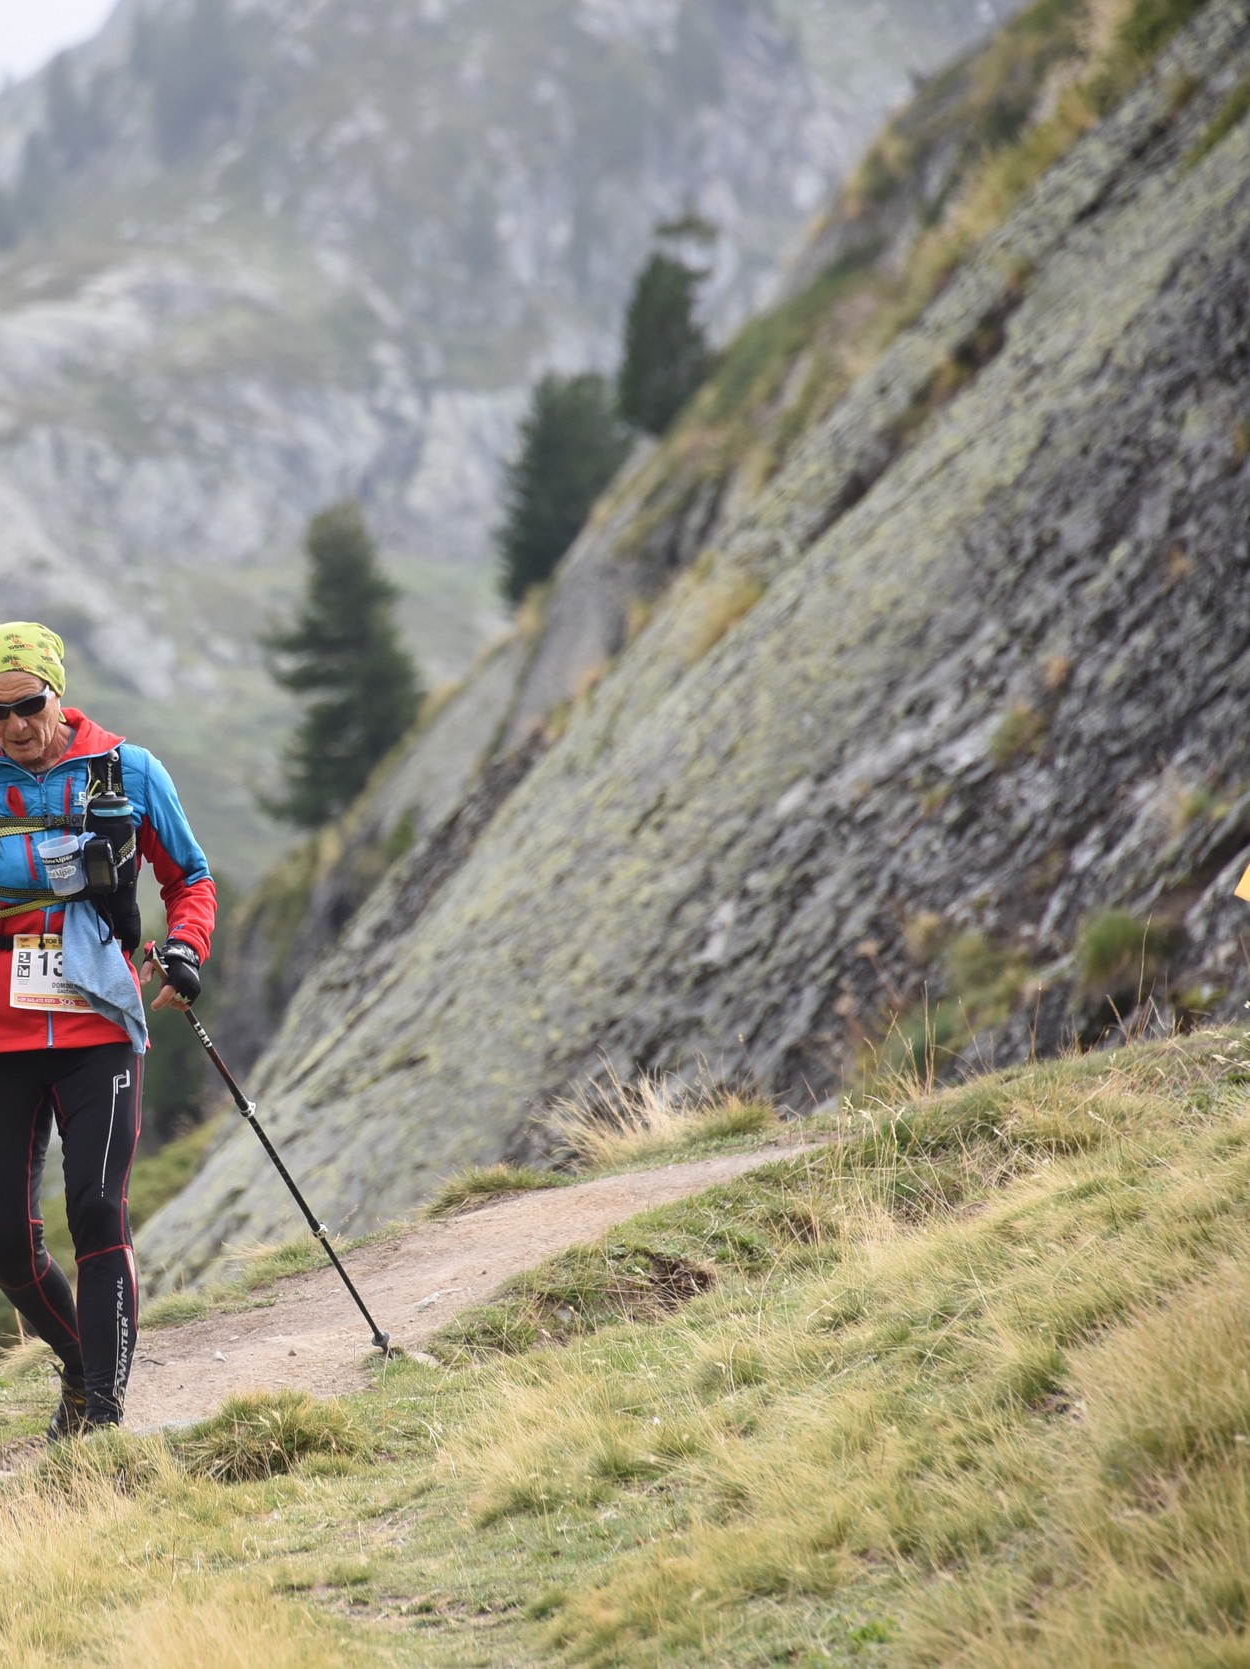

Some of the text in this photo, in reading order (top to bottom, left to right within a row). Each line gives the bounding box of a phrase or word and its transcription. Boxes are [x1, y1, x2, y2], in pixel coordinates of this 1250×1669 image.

[59, 998, 76, 1006] SOS
[193, 1021, 213, 1048] LEKI
[116, 1276, 124, 1320] TRAIL
[118, 1316, 129, 1386] WINTER
